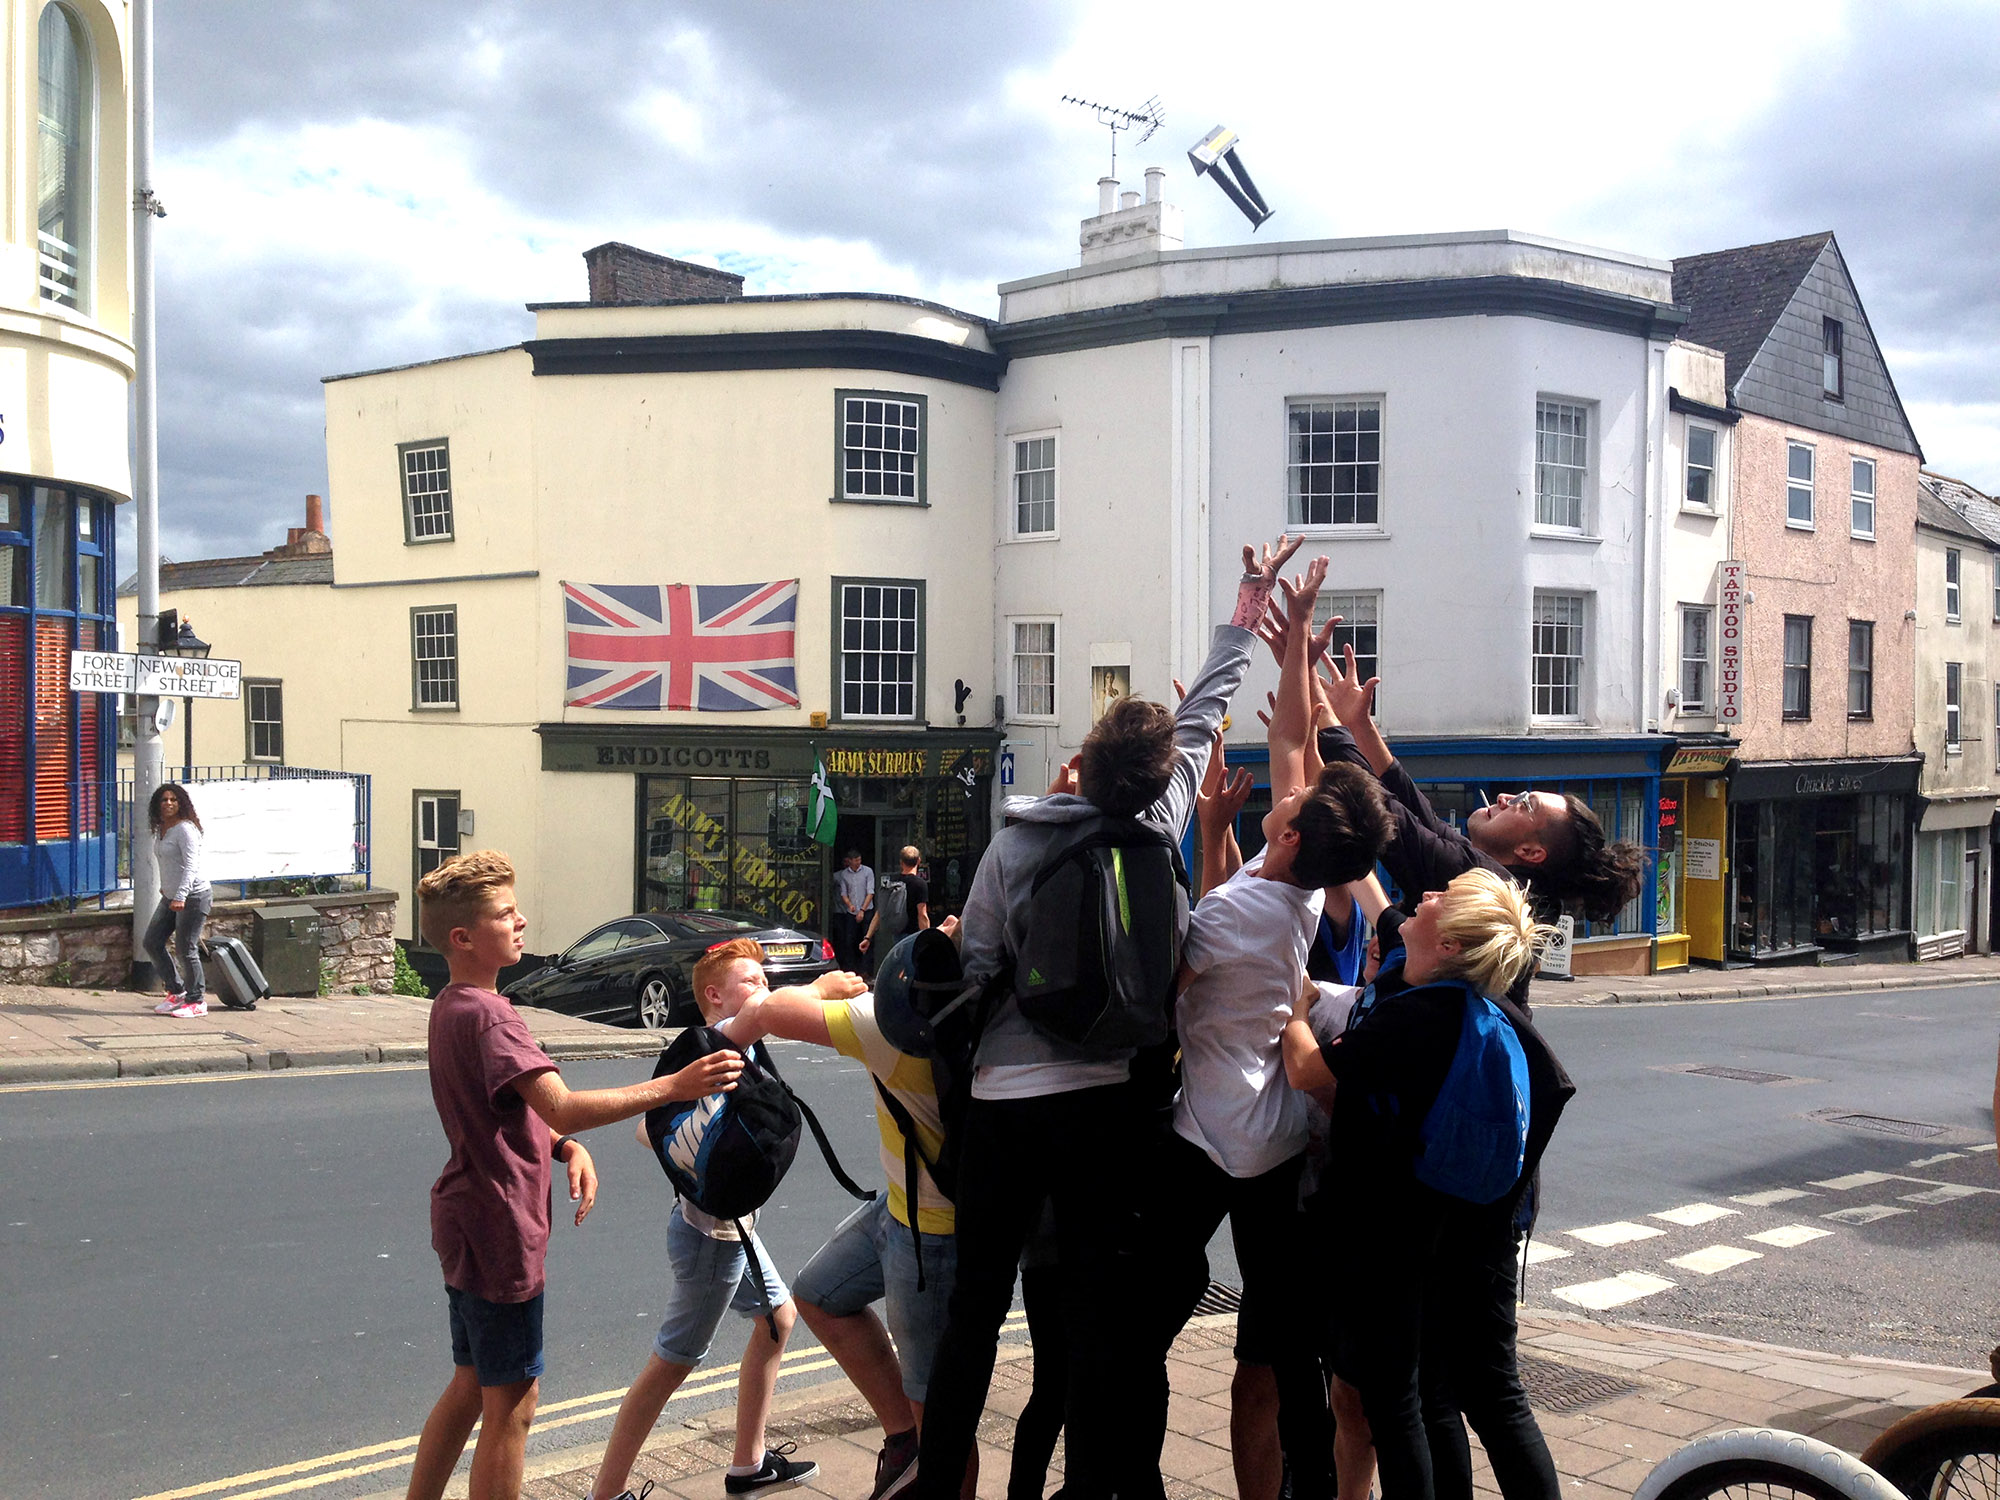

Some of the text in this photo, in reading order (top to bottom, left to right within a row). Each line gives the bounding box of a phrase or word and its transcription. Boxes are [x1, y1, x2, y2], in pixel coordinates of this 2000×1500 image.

[1722, 566, 1740, 718] TATTOO STUDIO
[82, 655, 125, 671] FORE
[139, 659, 238, 679] NEW BRIDGE
[72, 672, 134, 688] STREET
[159, 677, 217, 693] STREET
[596, 746, 771, 769] ENDICOTTS
[829, 750, 867, 774] ARMY
[868, 751, 923, 775] SURPLUS
[1795, 773, 1835, 793] Chuckle
[661, 793, 724, 850] ARMY
